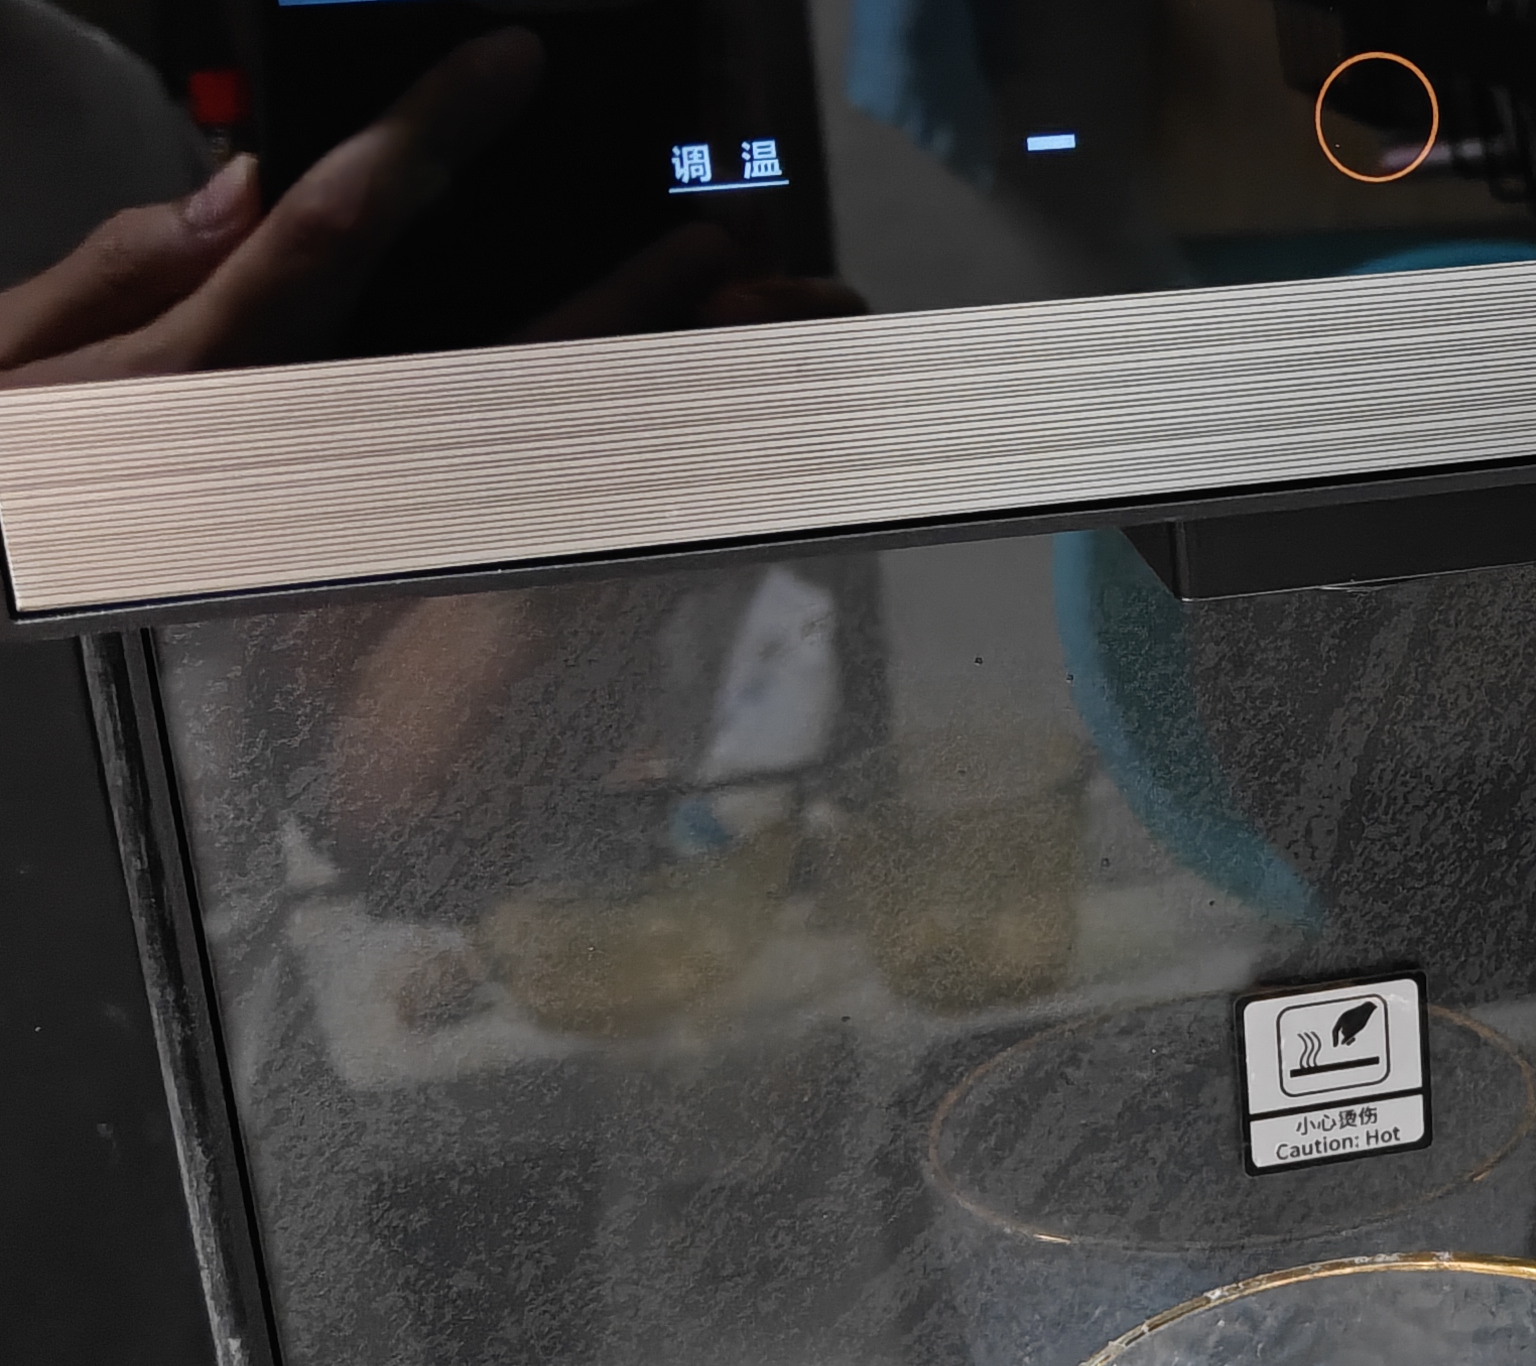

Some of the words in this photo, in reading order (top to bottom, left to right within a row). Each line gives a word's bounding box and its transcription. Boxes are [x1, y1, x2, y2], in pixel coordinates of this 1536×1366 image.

[1296, 1106, 1378, 1136] 小心烫伤
[1276, 1135, 1359, 1160] Caution:
[1366, 1126, 1400, 1146] Hot
